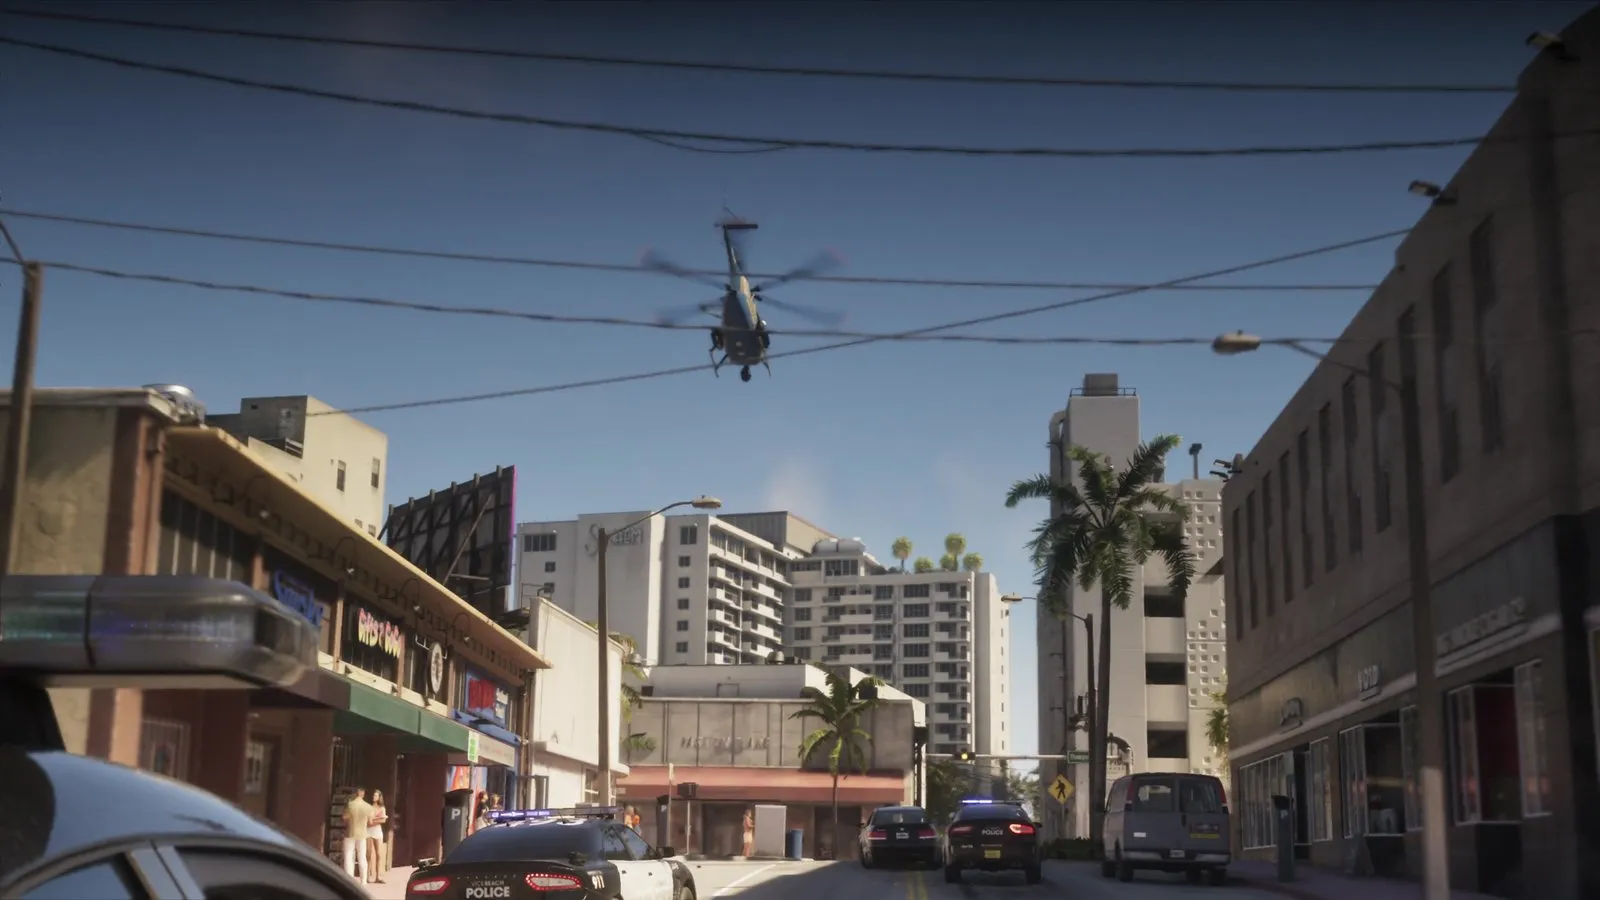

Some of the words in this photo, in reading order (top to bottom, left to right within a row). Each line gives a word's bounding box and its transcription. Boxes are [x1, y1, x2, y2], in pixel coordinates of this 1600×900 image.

[451, 808, 461, 820] P
[592, 875, 605, 890] 911
[465, 886, 511, 899] POLICE
